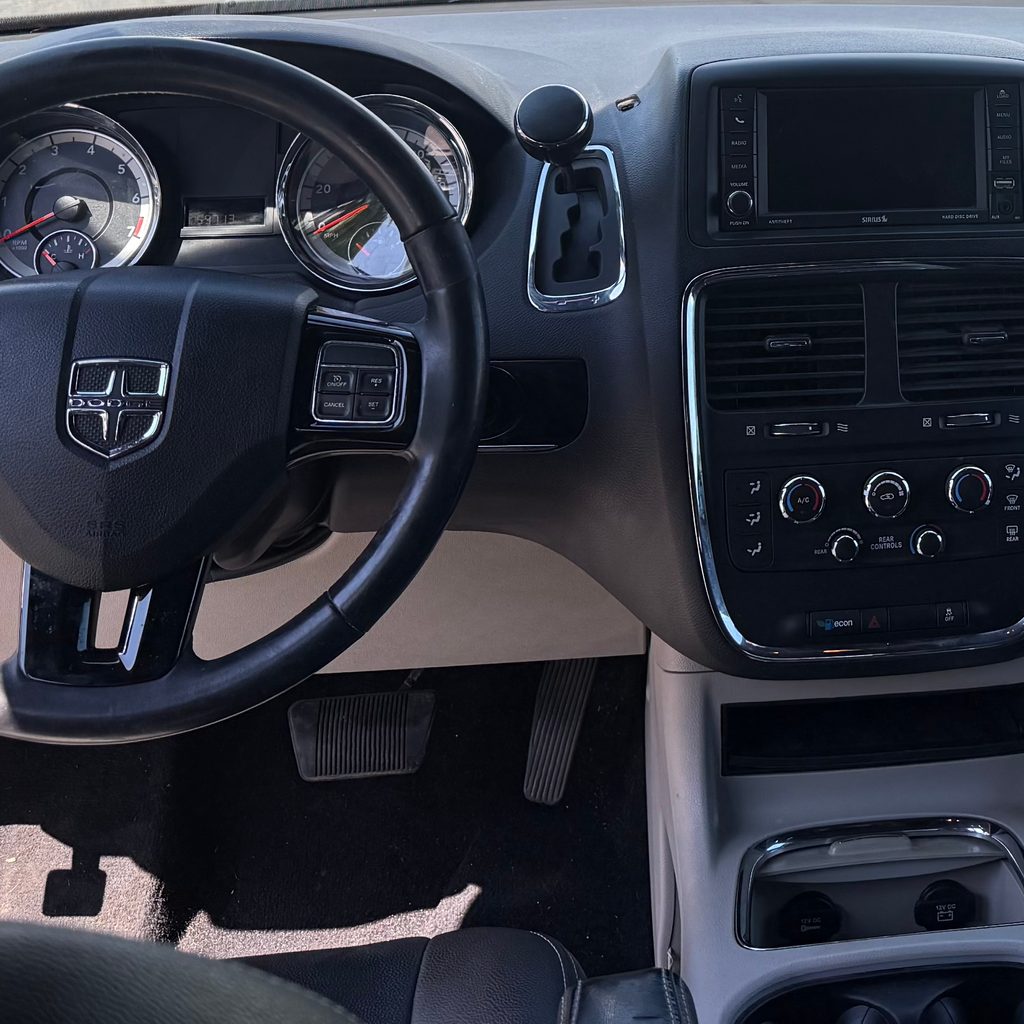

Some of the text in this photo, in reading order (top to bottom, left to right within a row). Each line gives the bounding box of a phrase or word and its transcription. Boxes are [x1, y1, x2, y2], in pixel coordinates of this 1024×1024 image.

[50, 145, 58, 156] 3
[86, 144, 95, 156] 4
[18, 164, 26, 175] 2
[118, 164, 126, 174] 5
[315, 184, 331, 194] 20
[2, 196, 7, 208] 1
[132, 192, 141, 204] 6
[127, 226, 136, 238] 7
[68, 398, 161, 408] DODGE
[870, 542, 902, 550] CONTROLS
[834, 619, 853, 628] econ
